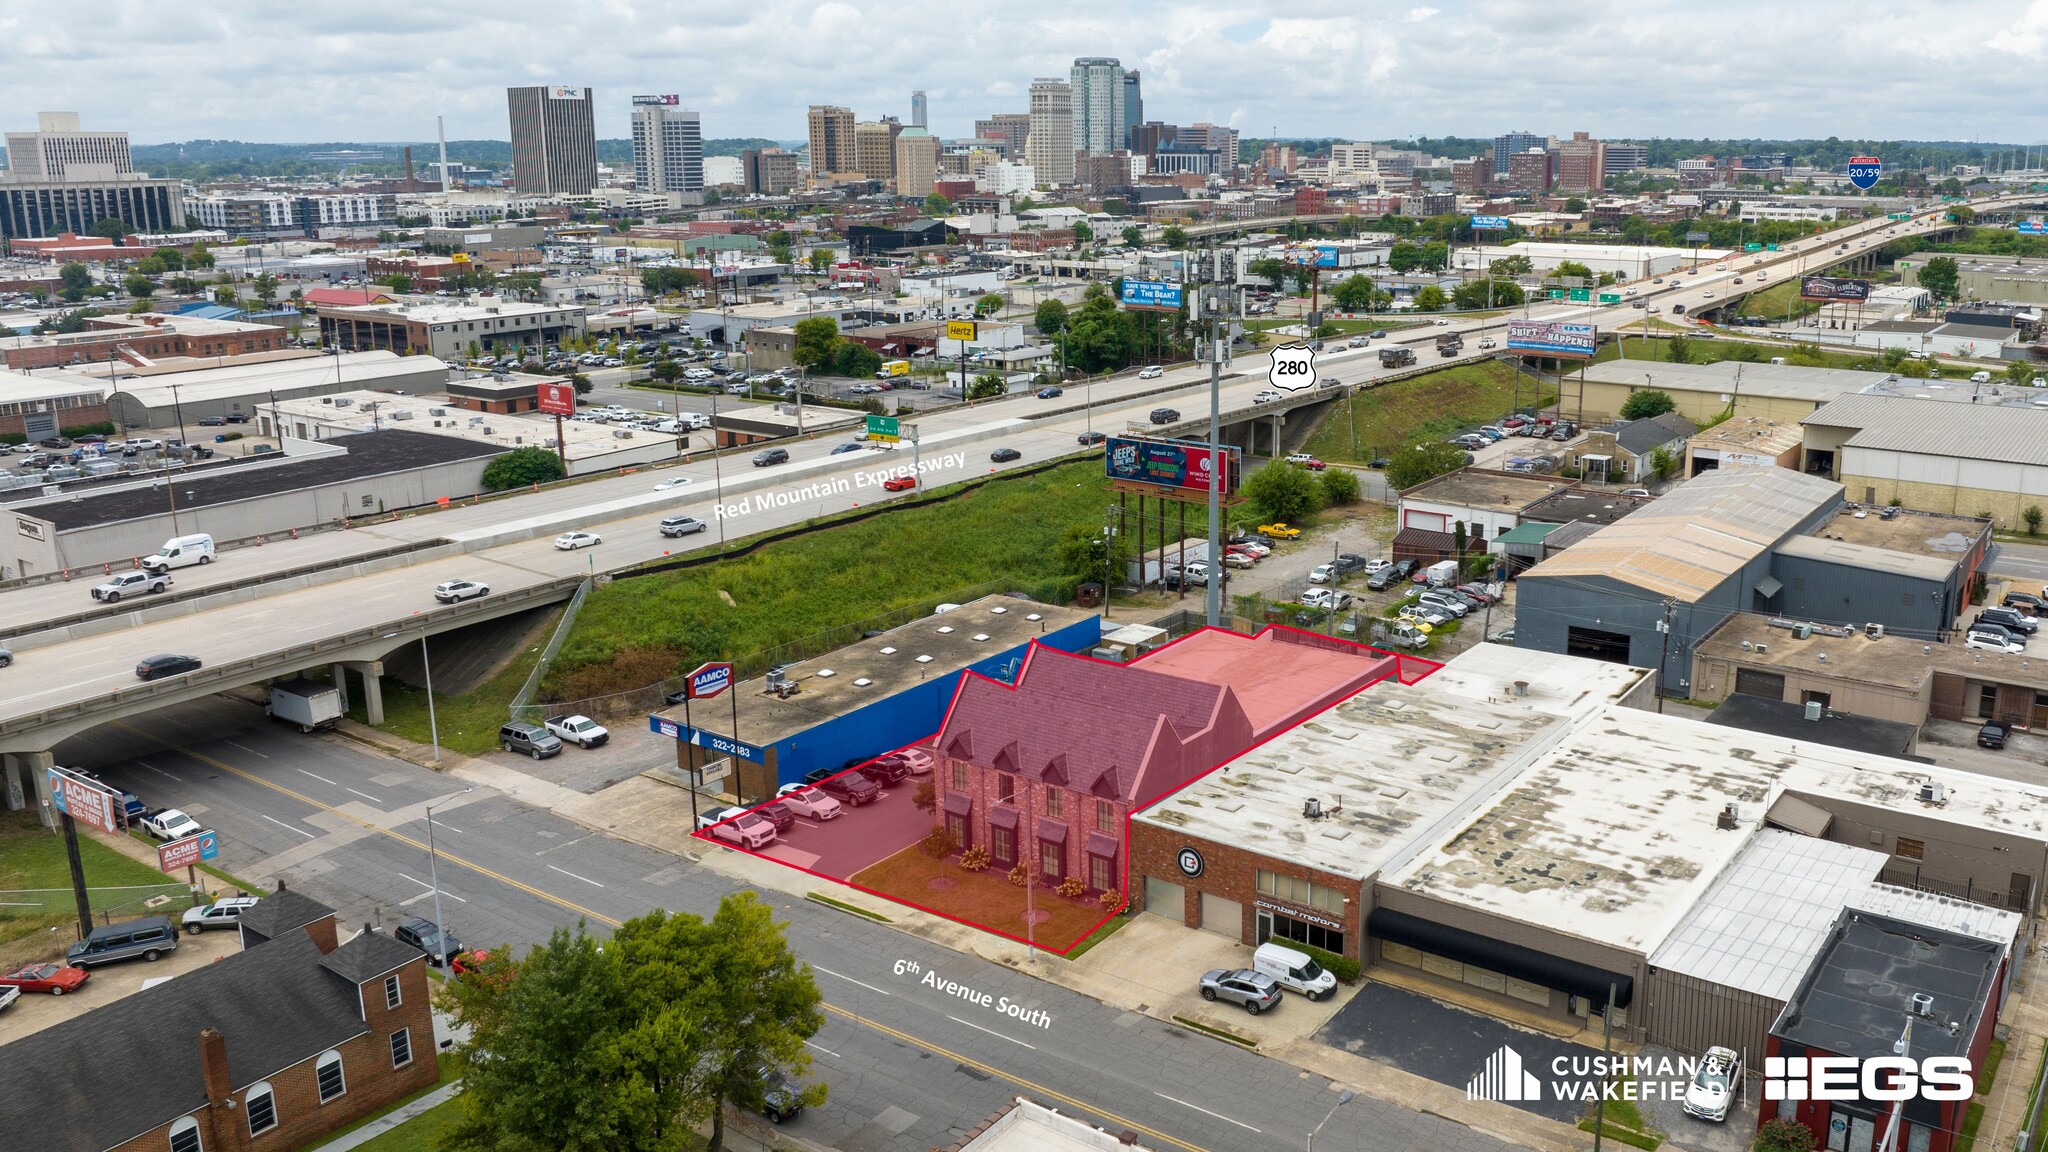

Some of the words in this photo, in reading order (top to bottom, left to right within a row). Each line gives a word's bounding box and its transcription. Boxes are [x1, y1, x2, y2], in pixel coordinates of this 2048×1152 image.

[564, 89, 577, 97] PNC
[950, 326, 972, 336] Hertz
[1511, 327, 1538, 337] SHIFT
[1547, 333, 1592, 348] HAPPENS!
[1112, 446, 1136, 460] JEEPS
[1146, 461, 1158, 470] JEEP
[693, 667, 730, 687] AAMCO
[660, 721, 678, 732] AAMCO
[65, 781, 102, 810] ACME
[66, 796, 85, 809] MUFFLER
[71, 804, 100, 826] 324-7697
[164, 841, 199, 859] ACME
[167, 854, 198, 869] 324-7697
[1256, 900, 1298, 916] combat
[1299, 912, 1340, 929] motors
